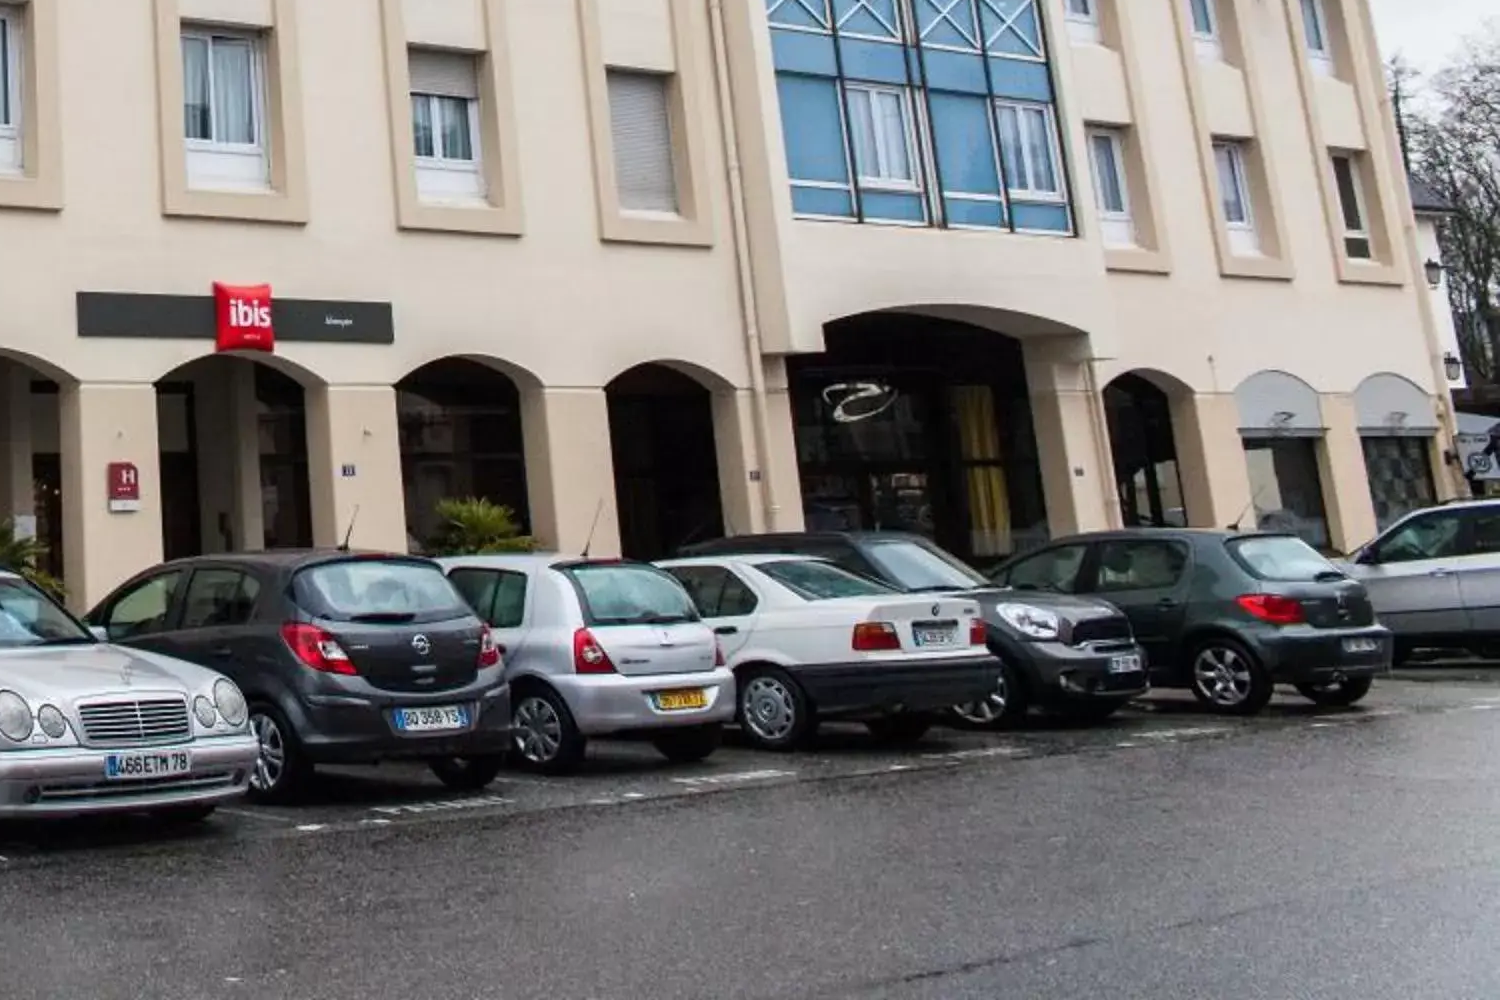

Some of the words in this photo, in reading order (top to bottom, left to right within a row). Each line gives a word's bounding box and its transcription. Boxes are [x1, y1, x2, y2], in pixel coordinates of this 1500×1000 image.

[229, 299, 271, 328] ibis
[121, 469, 135, 485] H
[172, 752, 187, 771] 78
